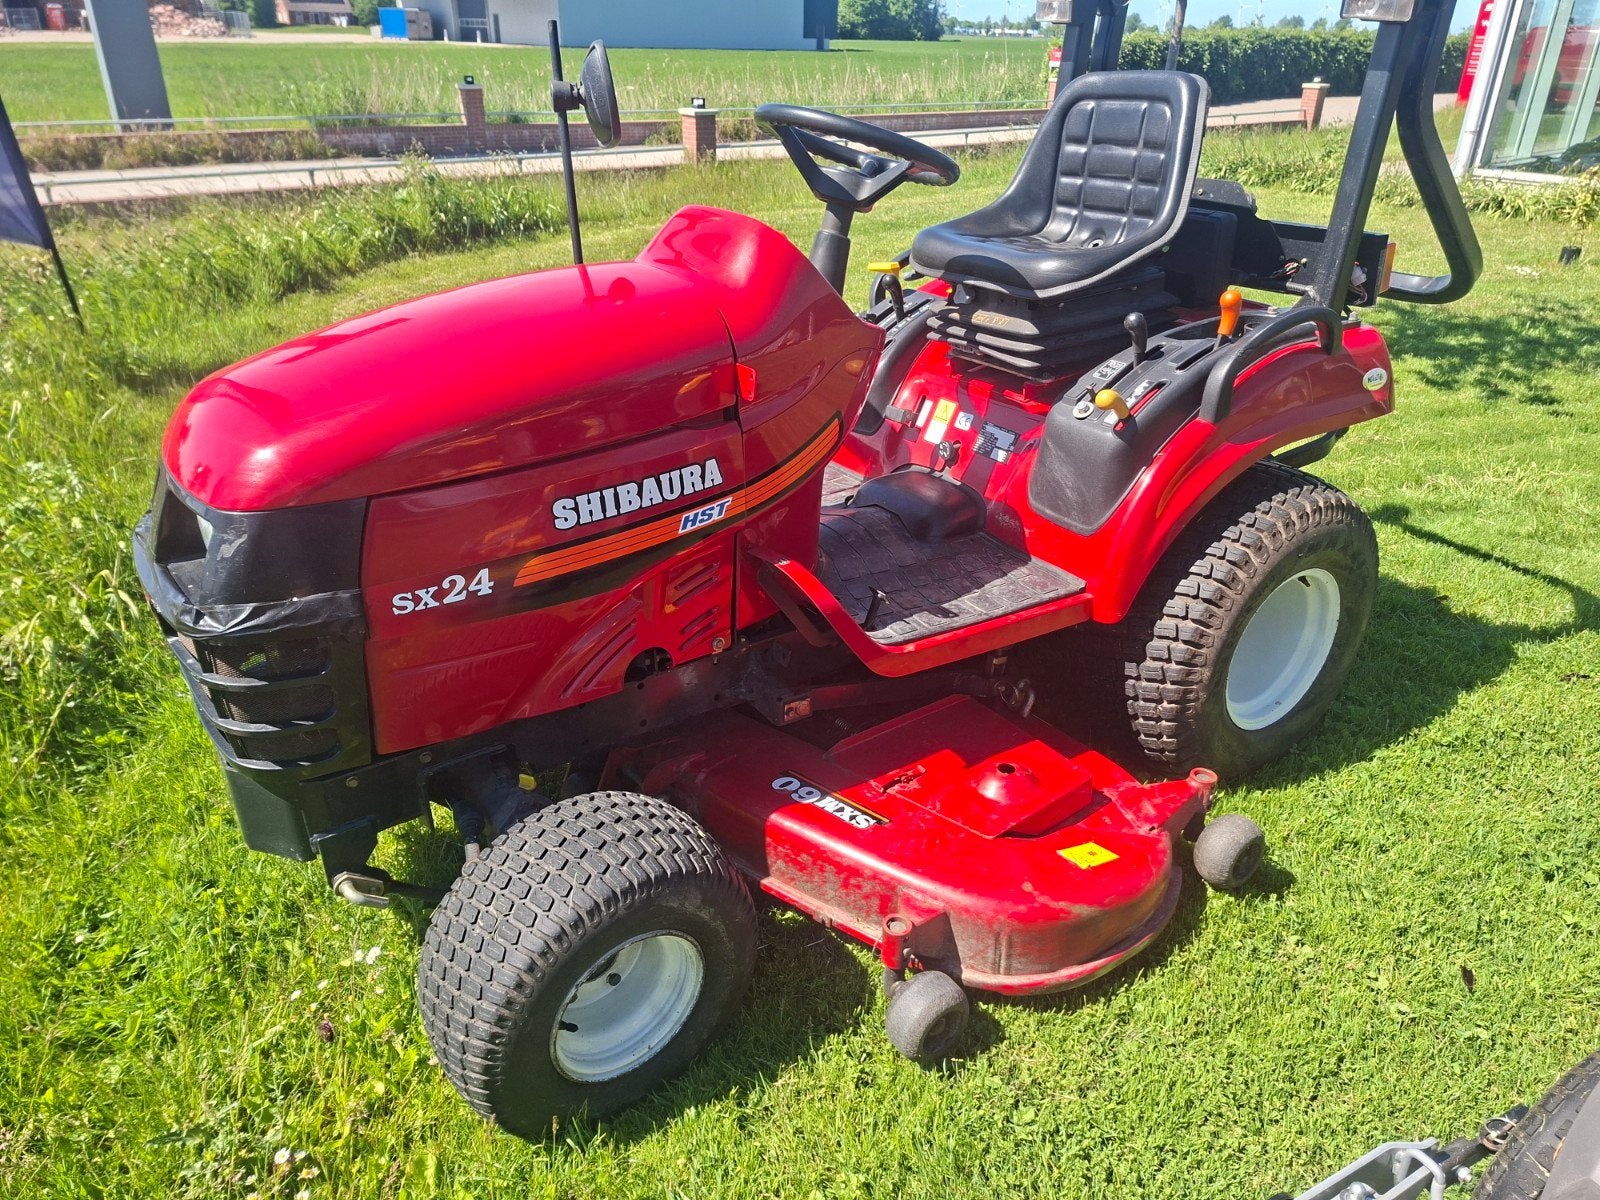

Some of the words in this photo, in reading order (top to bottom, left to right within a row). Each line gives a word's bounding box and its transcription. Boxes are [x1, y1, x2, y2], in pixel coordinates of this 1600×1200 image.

[551, 457, 723, 530] SHIBAURA
[680, 498, 732, 532] HST
[391, 567, 494, 615] SX24
